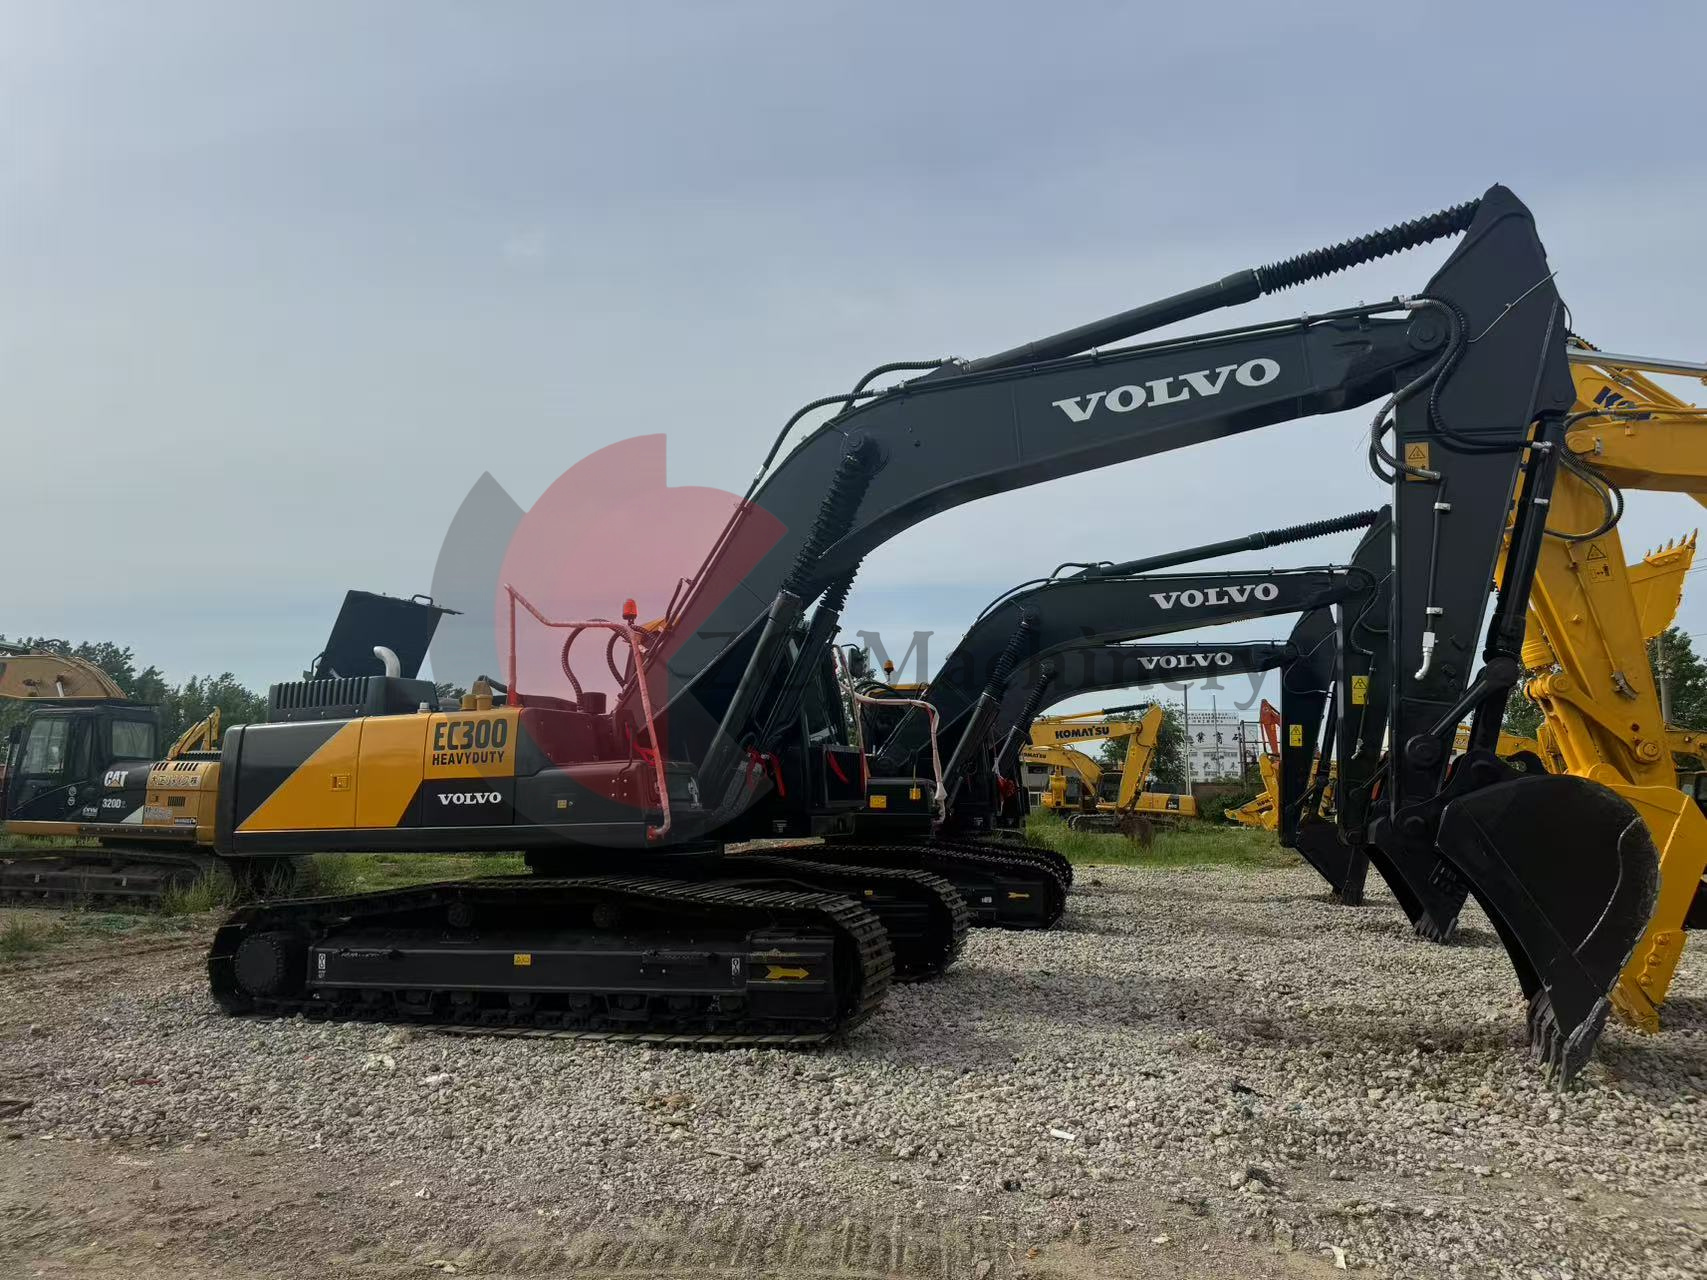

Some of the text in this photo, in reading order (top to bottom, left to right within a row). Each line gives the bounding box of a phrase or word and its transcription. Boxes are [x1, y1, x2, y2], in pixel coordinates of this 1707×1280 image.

[1052, 358, 1280, 422] VOLVO
[1149, 583, 1279, 609] VOLVO
[1137, 652, 1233, 670] VOLVO
[433, 719, 508, 751] EC300
[1055, 726, 1109, 739] KOMATSU
[104, 771, 128, 787] CAT
[437, 791, 502, 805] VOLVO
